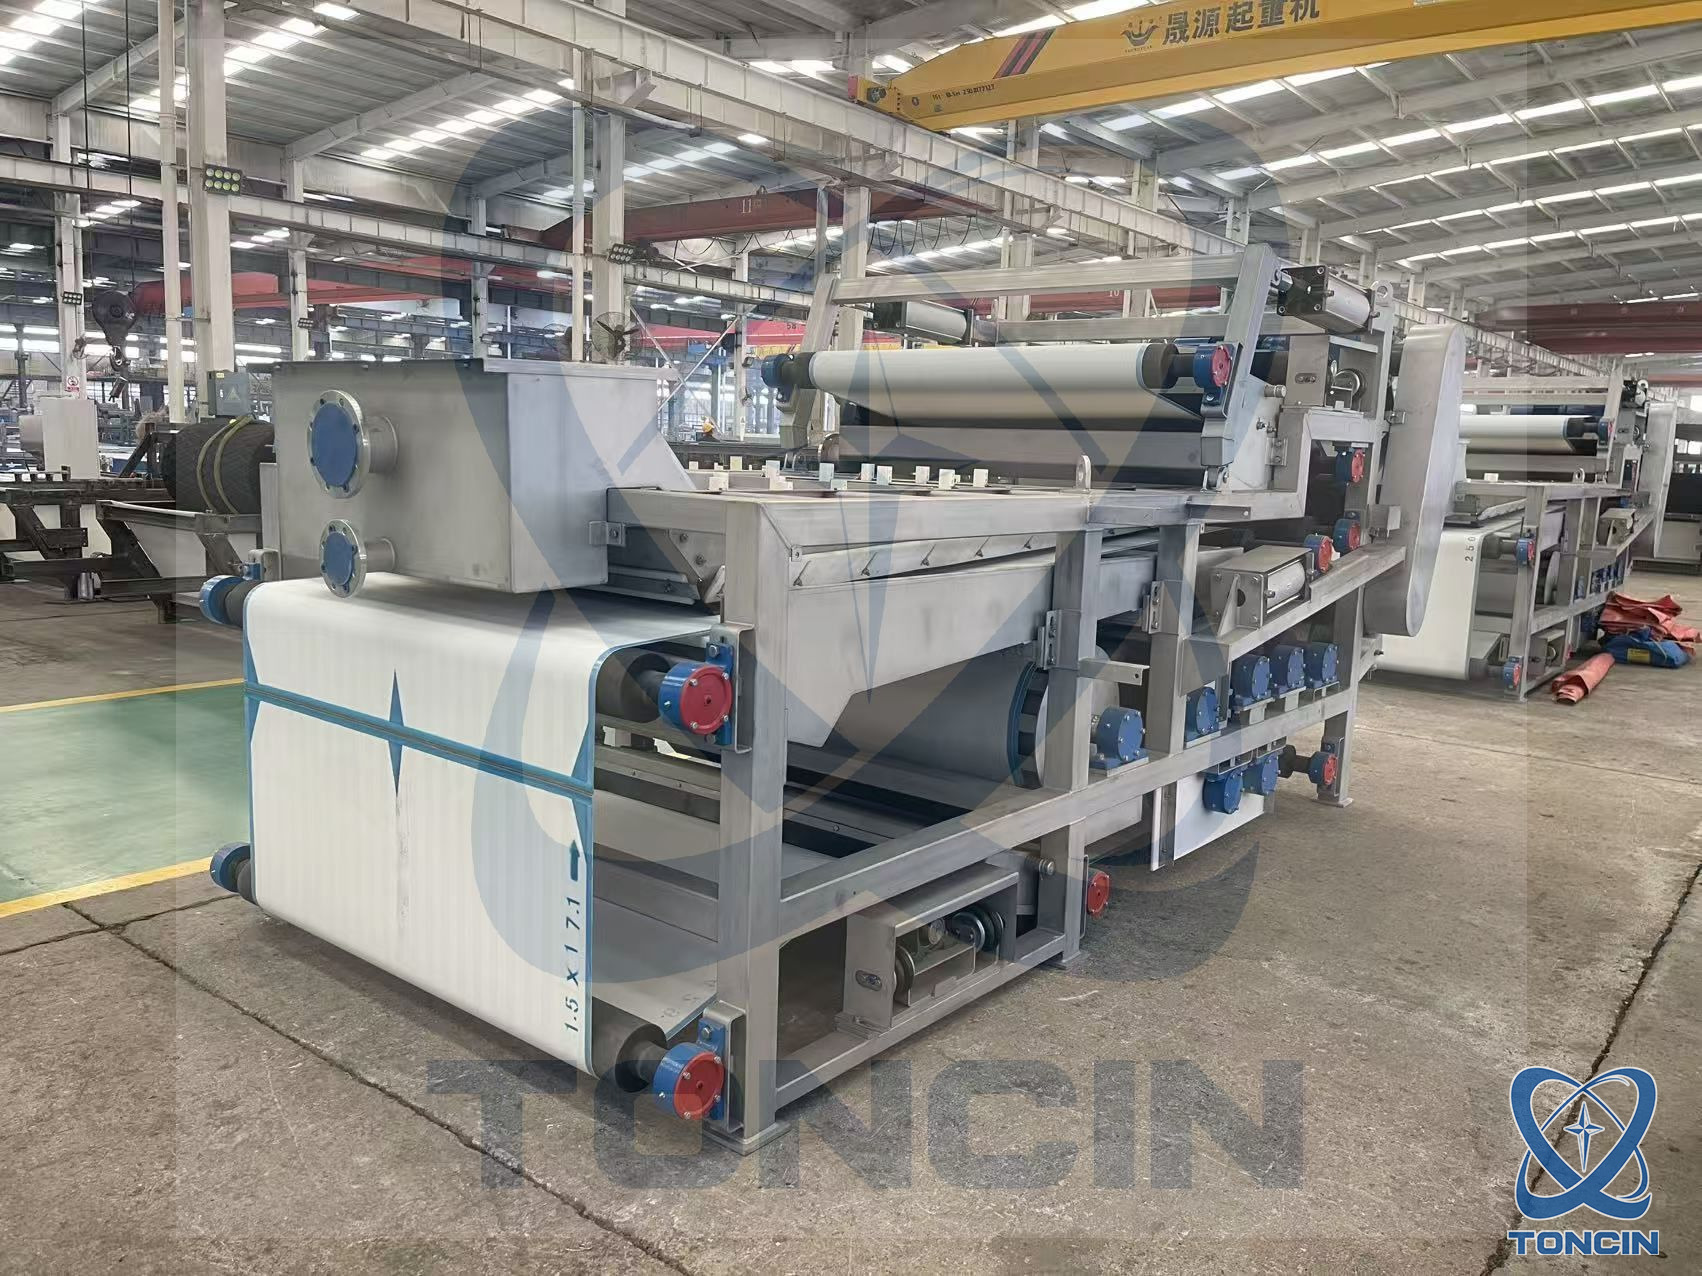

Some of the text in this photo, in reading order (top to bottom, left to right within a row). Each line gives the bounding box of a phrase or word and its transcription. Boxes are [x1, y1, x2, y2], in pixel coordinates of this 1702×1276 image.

[1162, 0, 1320, 45] 晟源起重机
